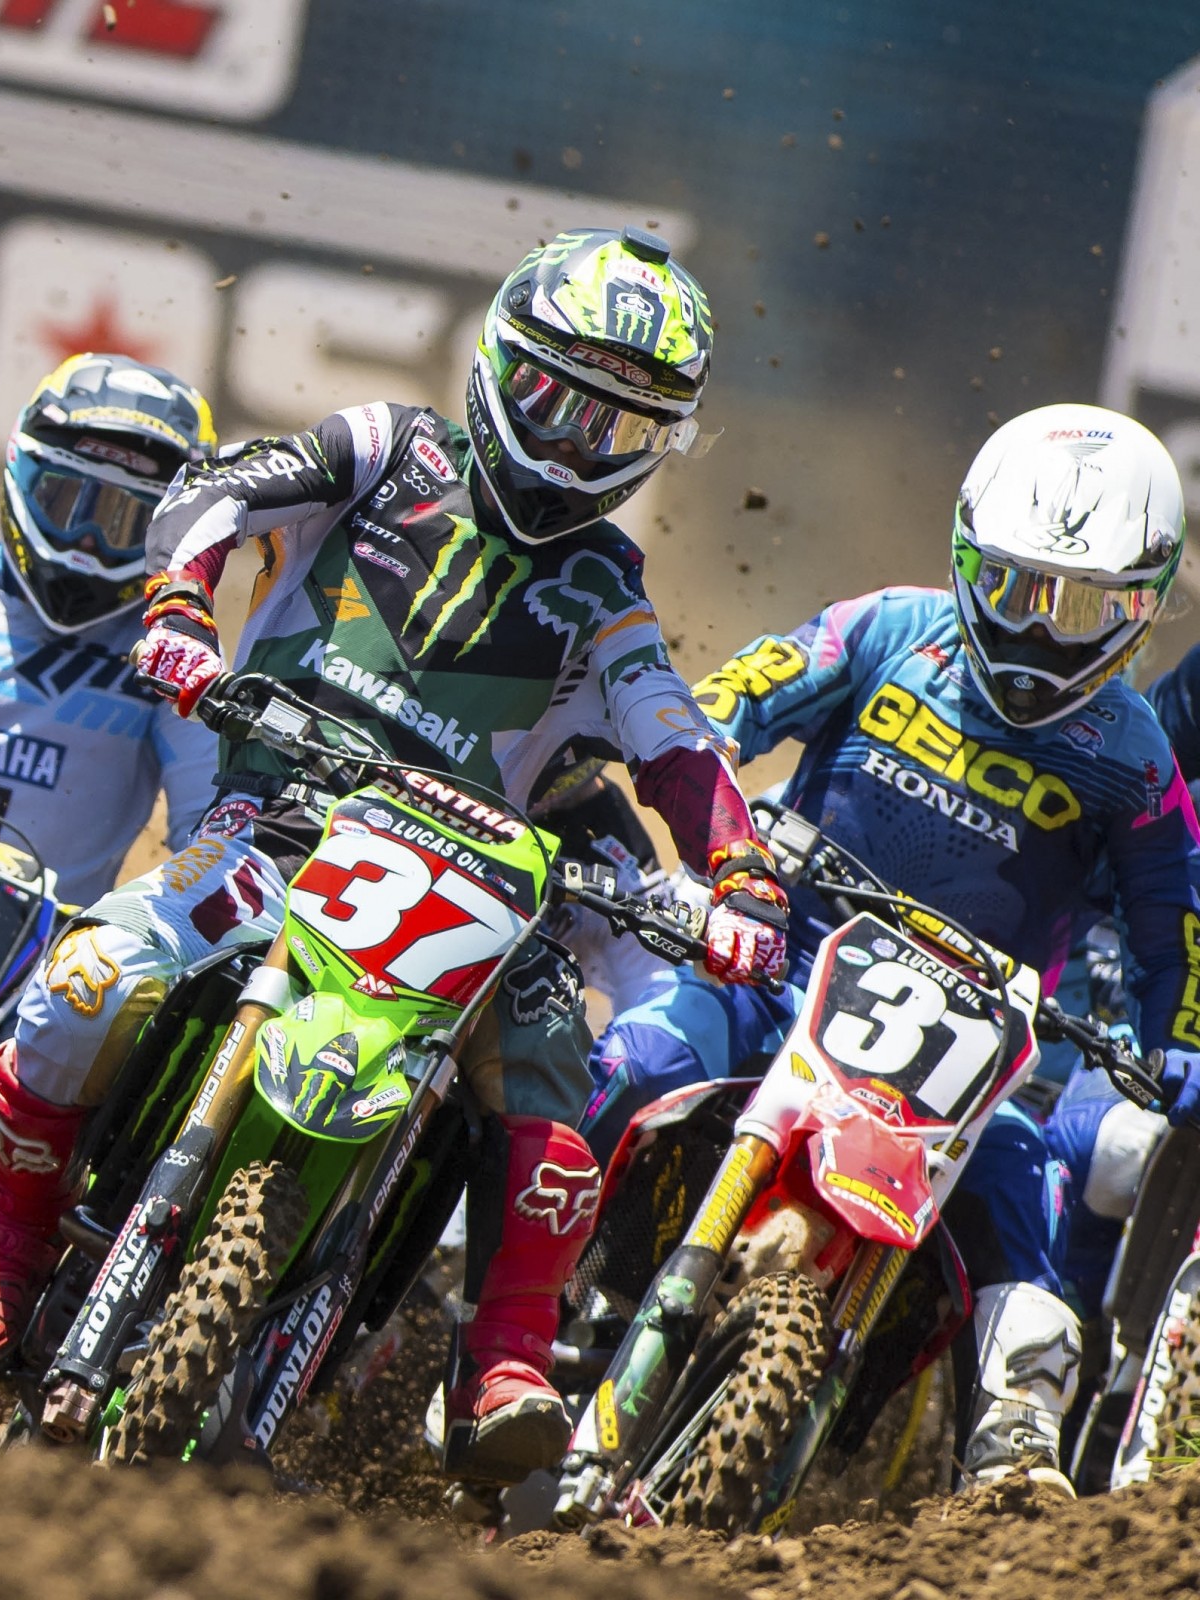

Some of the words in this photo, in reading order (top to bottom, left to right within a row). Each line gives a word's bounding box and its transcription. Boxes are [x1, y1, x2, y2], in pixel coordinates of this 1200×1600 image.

[524, 325, 566, 351] CIRCUIT
[568, 343, 628, 376] FLEX
[416, 442, 448, 479] BELL
[1042, 428, 1115, 441] AMSOIL
[402, 465, 431, 496] 360
[548, 467, 570, 482] BELL
[356, 517, 403, 544] SCOTT
[298, 638, 479, 765] Kawasaki
[858, 683, 1082, 830] GEICO
[860, 748, 1020, 853] HONDA
[390, 819, 459, 858] LUCAS
[455, 853, 487, 879] OIL
[289, 833, 533, 992] 37
[638, 929, 688, 959] ARC
[897, 948, 958, 989] LUCAS
[955, 983, 983, 1010] OIL
[215, 1021, 247, 1077] PRO
[322, 1053, 351, 1073] BELL
[822, 961, 1001, 1117] 31
[1115, 1067, 1156, 1103] ARC
[163, 1148, 190, 1167] 360
[373, 1112, 424, 1213] CIRCUIT
[826, 1172, 915, 1235] GEICO
[832, 1186, 905, 1240] HONDA
[253, 1284, 333, 1450] DUNLOP
